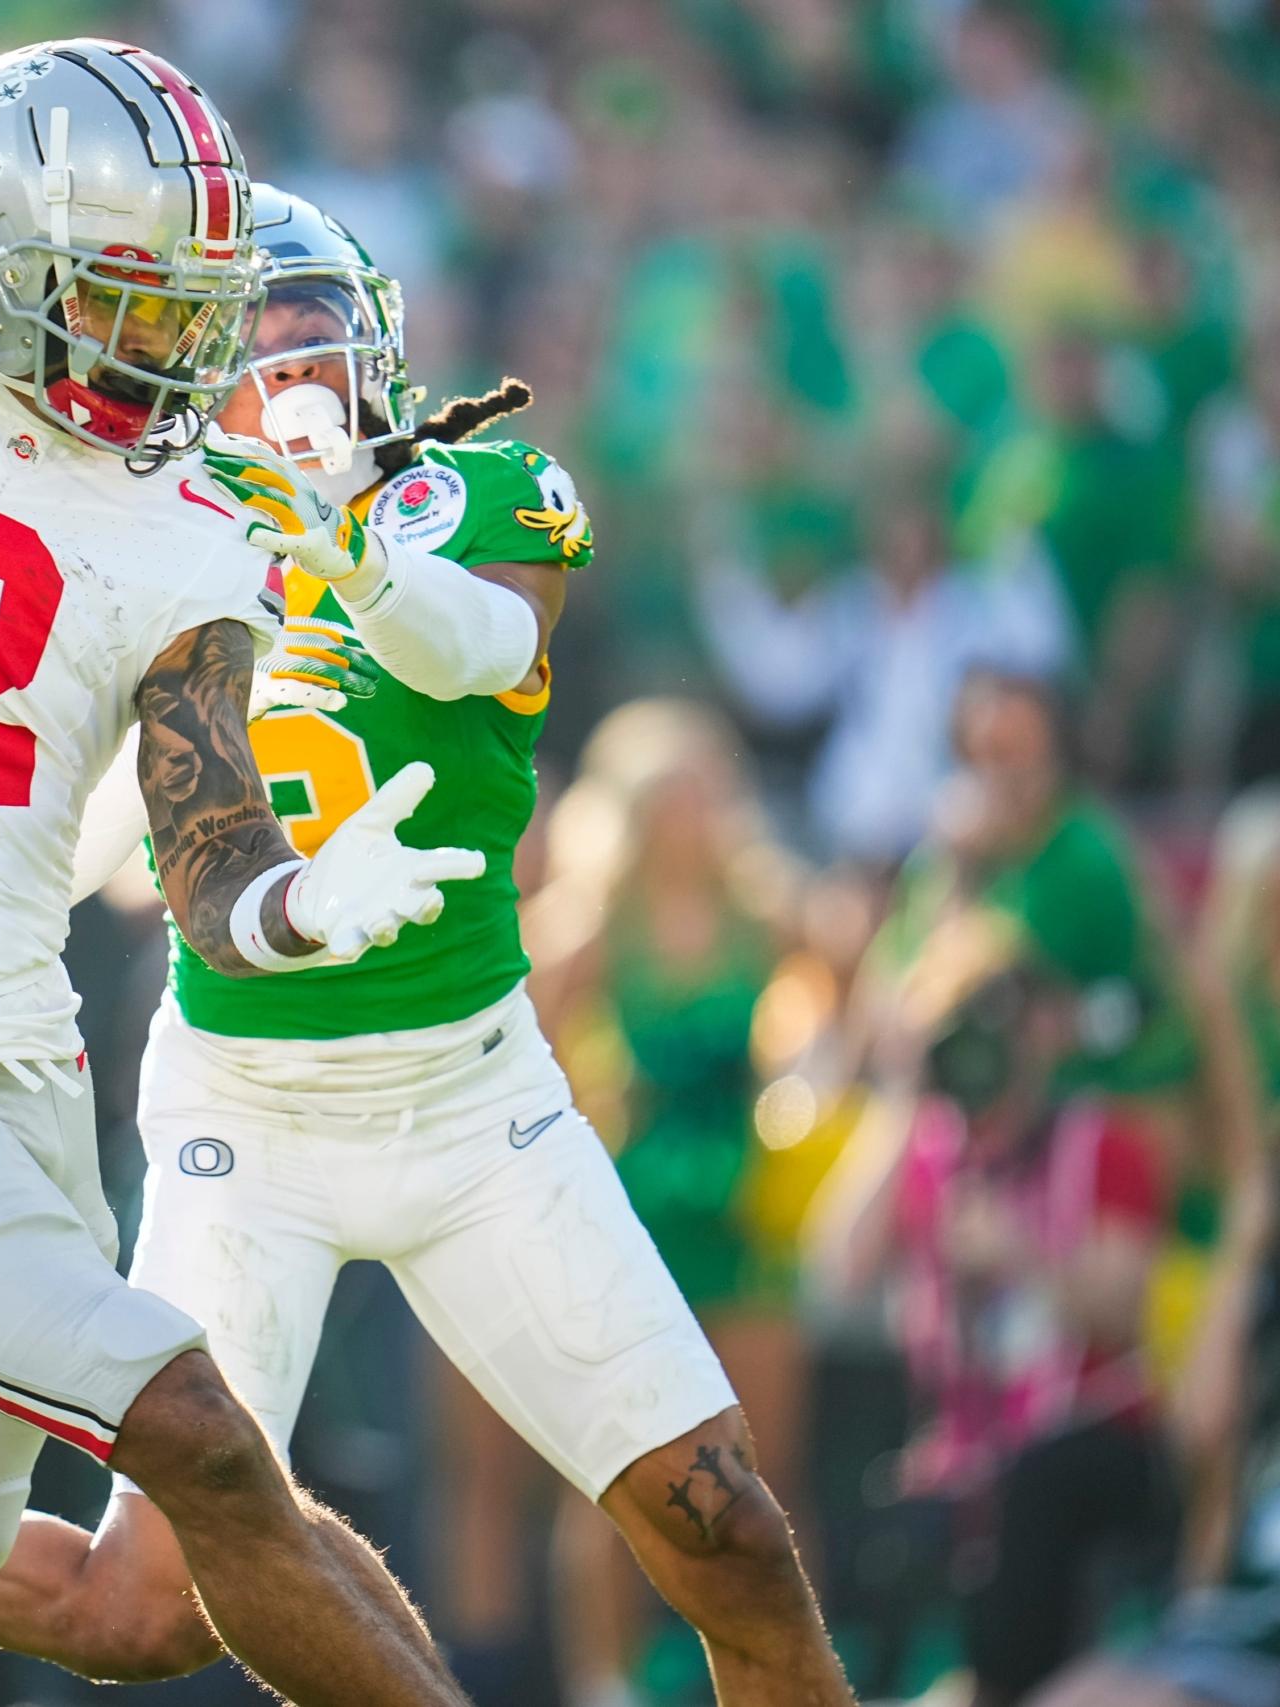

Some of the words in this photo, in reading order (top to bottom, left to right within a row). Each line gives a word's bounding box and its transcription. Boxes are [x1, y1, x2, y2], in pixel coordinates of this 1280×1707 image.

[176, 329, 197, 354] OHIO
[374, 490, 394, 526] ROSE
[392, 469, 433, 490] BOWL
[435, 470, 461, 498] GAME
[195, 805, 267, 838] Worship
